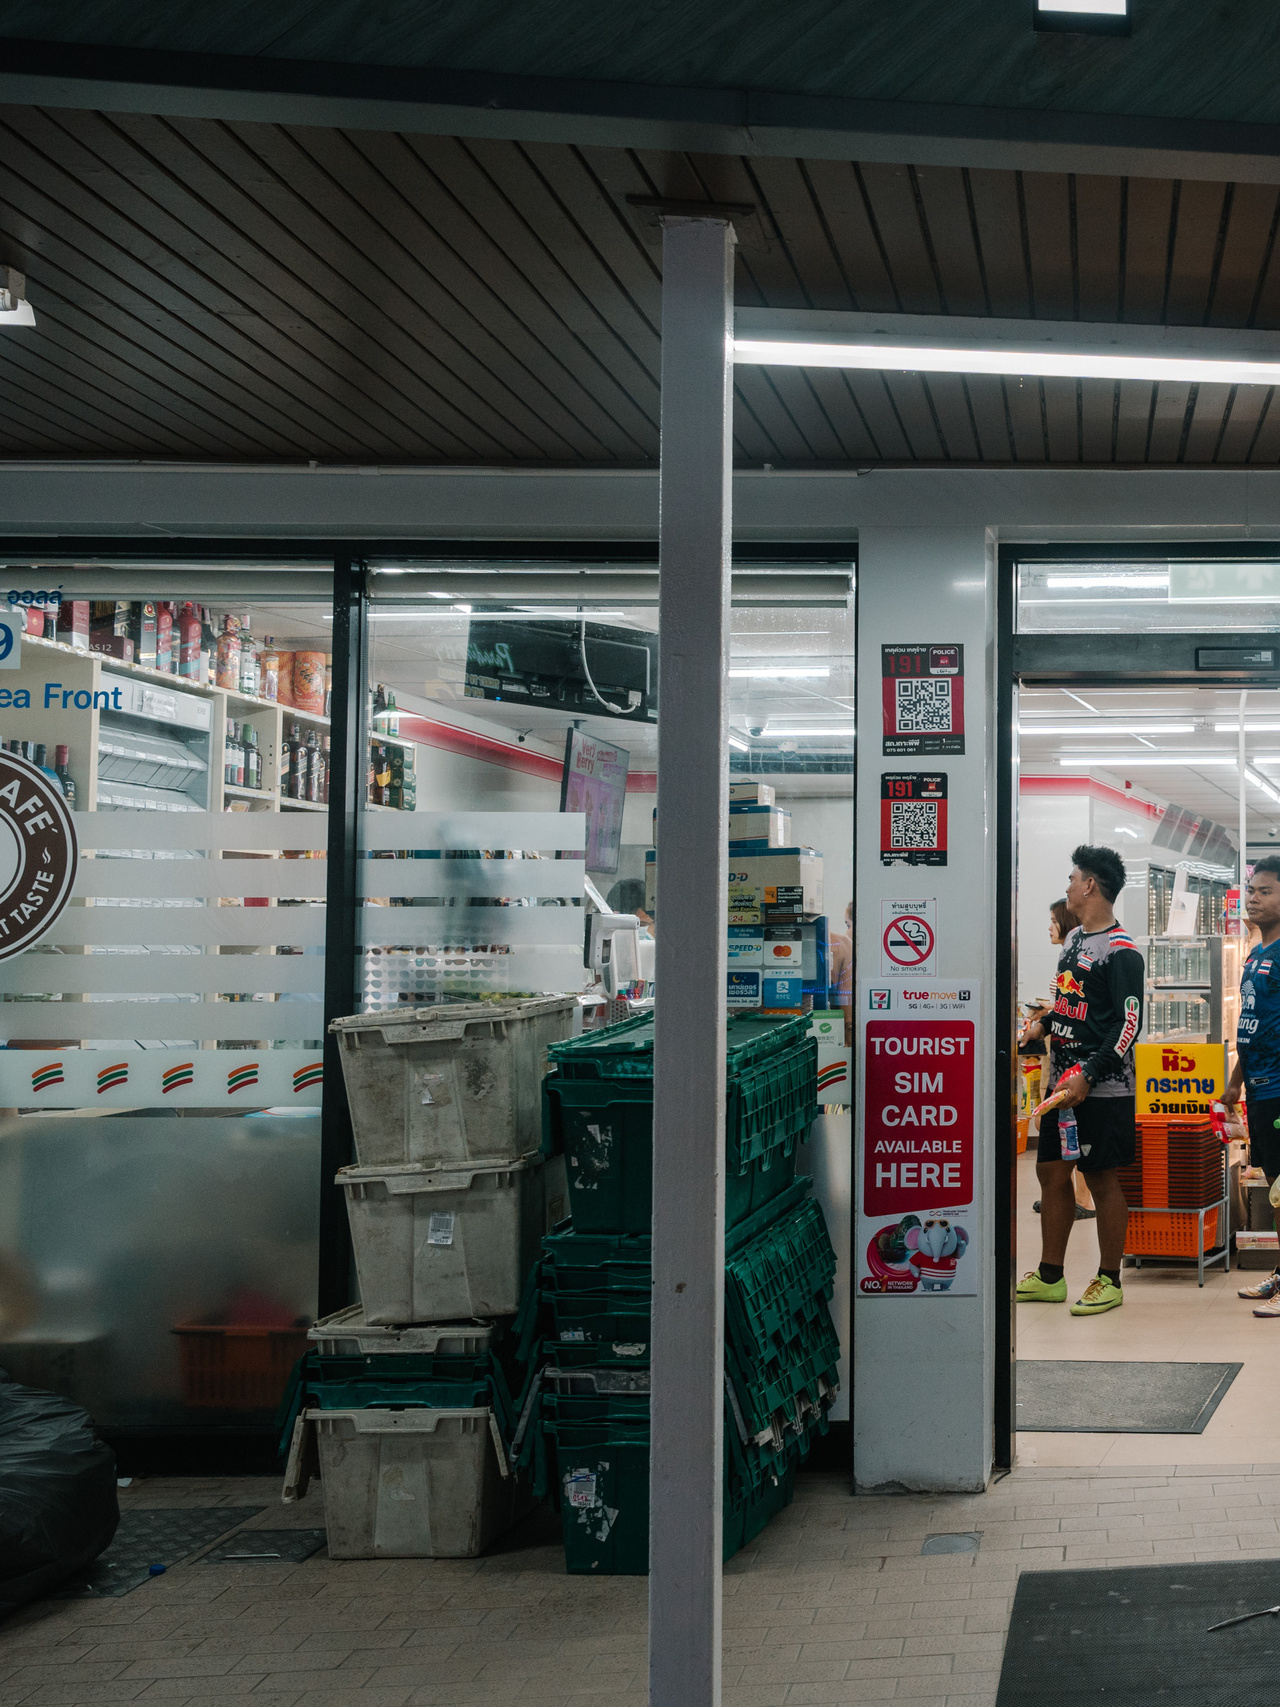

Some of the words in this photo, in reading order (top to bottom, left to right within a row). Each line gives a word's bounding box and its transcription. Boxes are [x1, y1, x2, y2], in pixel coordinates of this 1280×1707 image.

[888, 655, 921, 674] 191
[0, 689, 31, 709] ea
[44, 683, 122, 710] Front
[582, 738, 597, 758] Very
[576, 751, 595, 774] Berry
[887, 781, 913, 797] 191
[0, 779, 59, 836] AFÉ
[9, 870, 55, 925] TASTE
[1054, 994, 1088, 1022] dBull
[1051, 1020, 1075, 1039] TUL
[1117, 1012, 1138, 1053] Castrol
[1238, 1017, 1260, 1034] ang
[870, 1037, 970, 1056] TOURIST
[1162, 1048, 1196, 1072] หิว
[894, 1072, 944, 1093] SIM
[1146, 1077, 1215, 1094] กระหาย
[881, 1105, 958, 1127] CARD
[874, 1140, 962, 1154] AVAILABLE
[874, 1162, 962, 1188] HERE
